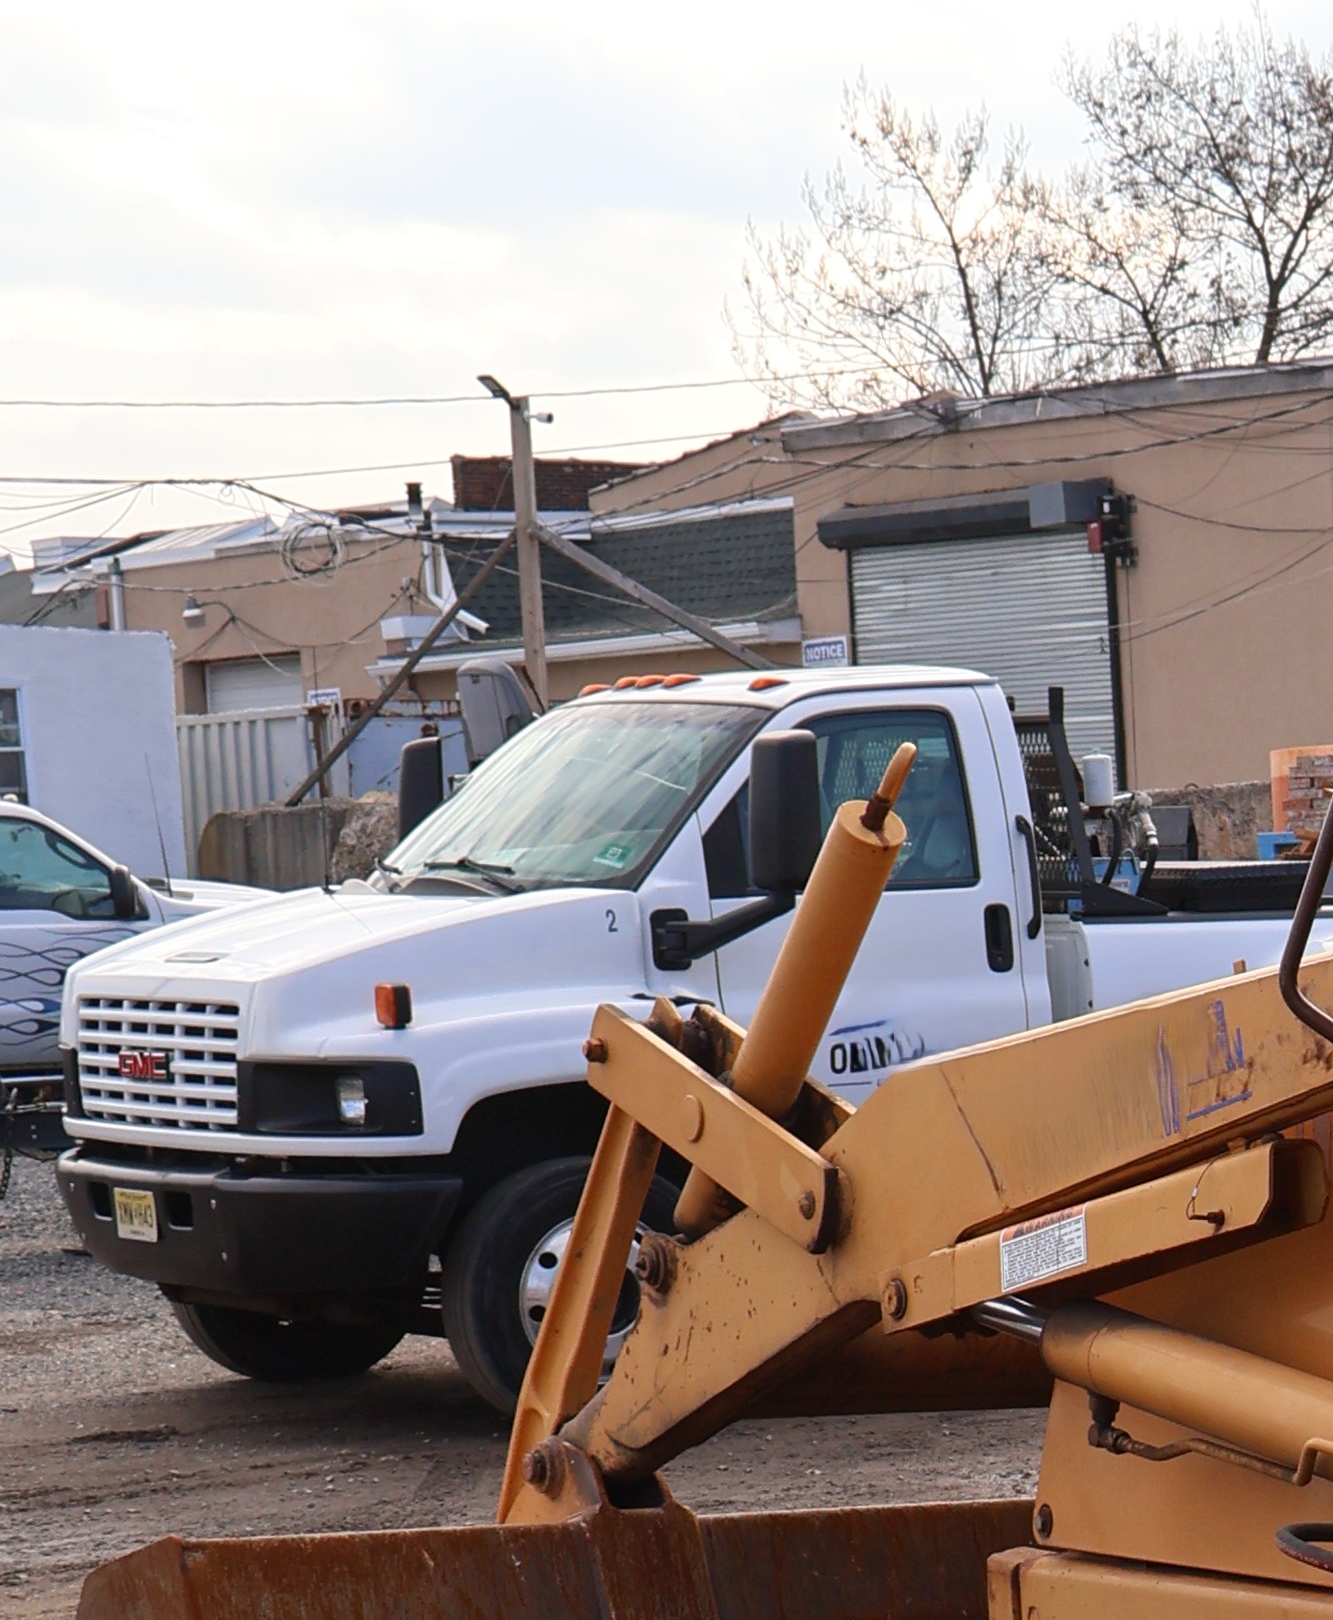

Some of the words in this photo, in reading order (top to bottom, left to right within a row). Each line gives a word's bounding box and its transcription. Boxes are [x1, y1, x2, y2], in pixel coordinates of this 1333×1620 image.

[805, 644, 844, 661] NOTICE
[605, 908, 618, 932] 2
[118, 1051, 167, 1079] GMC
